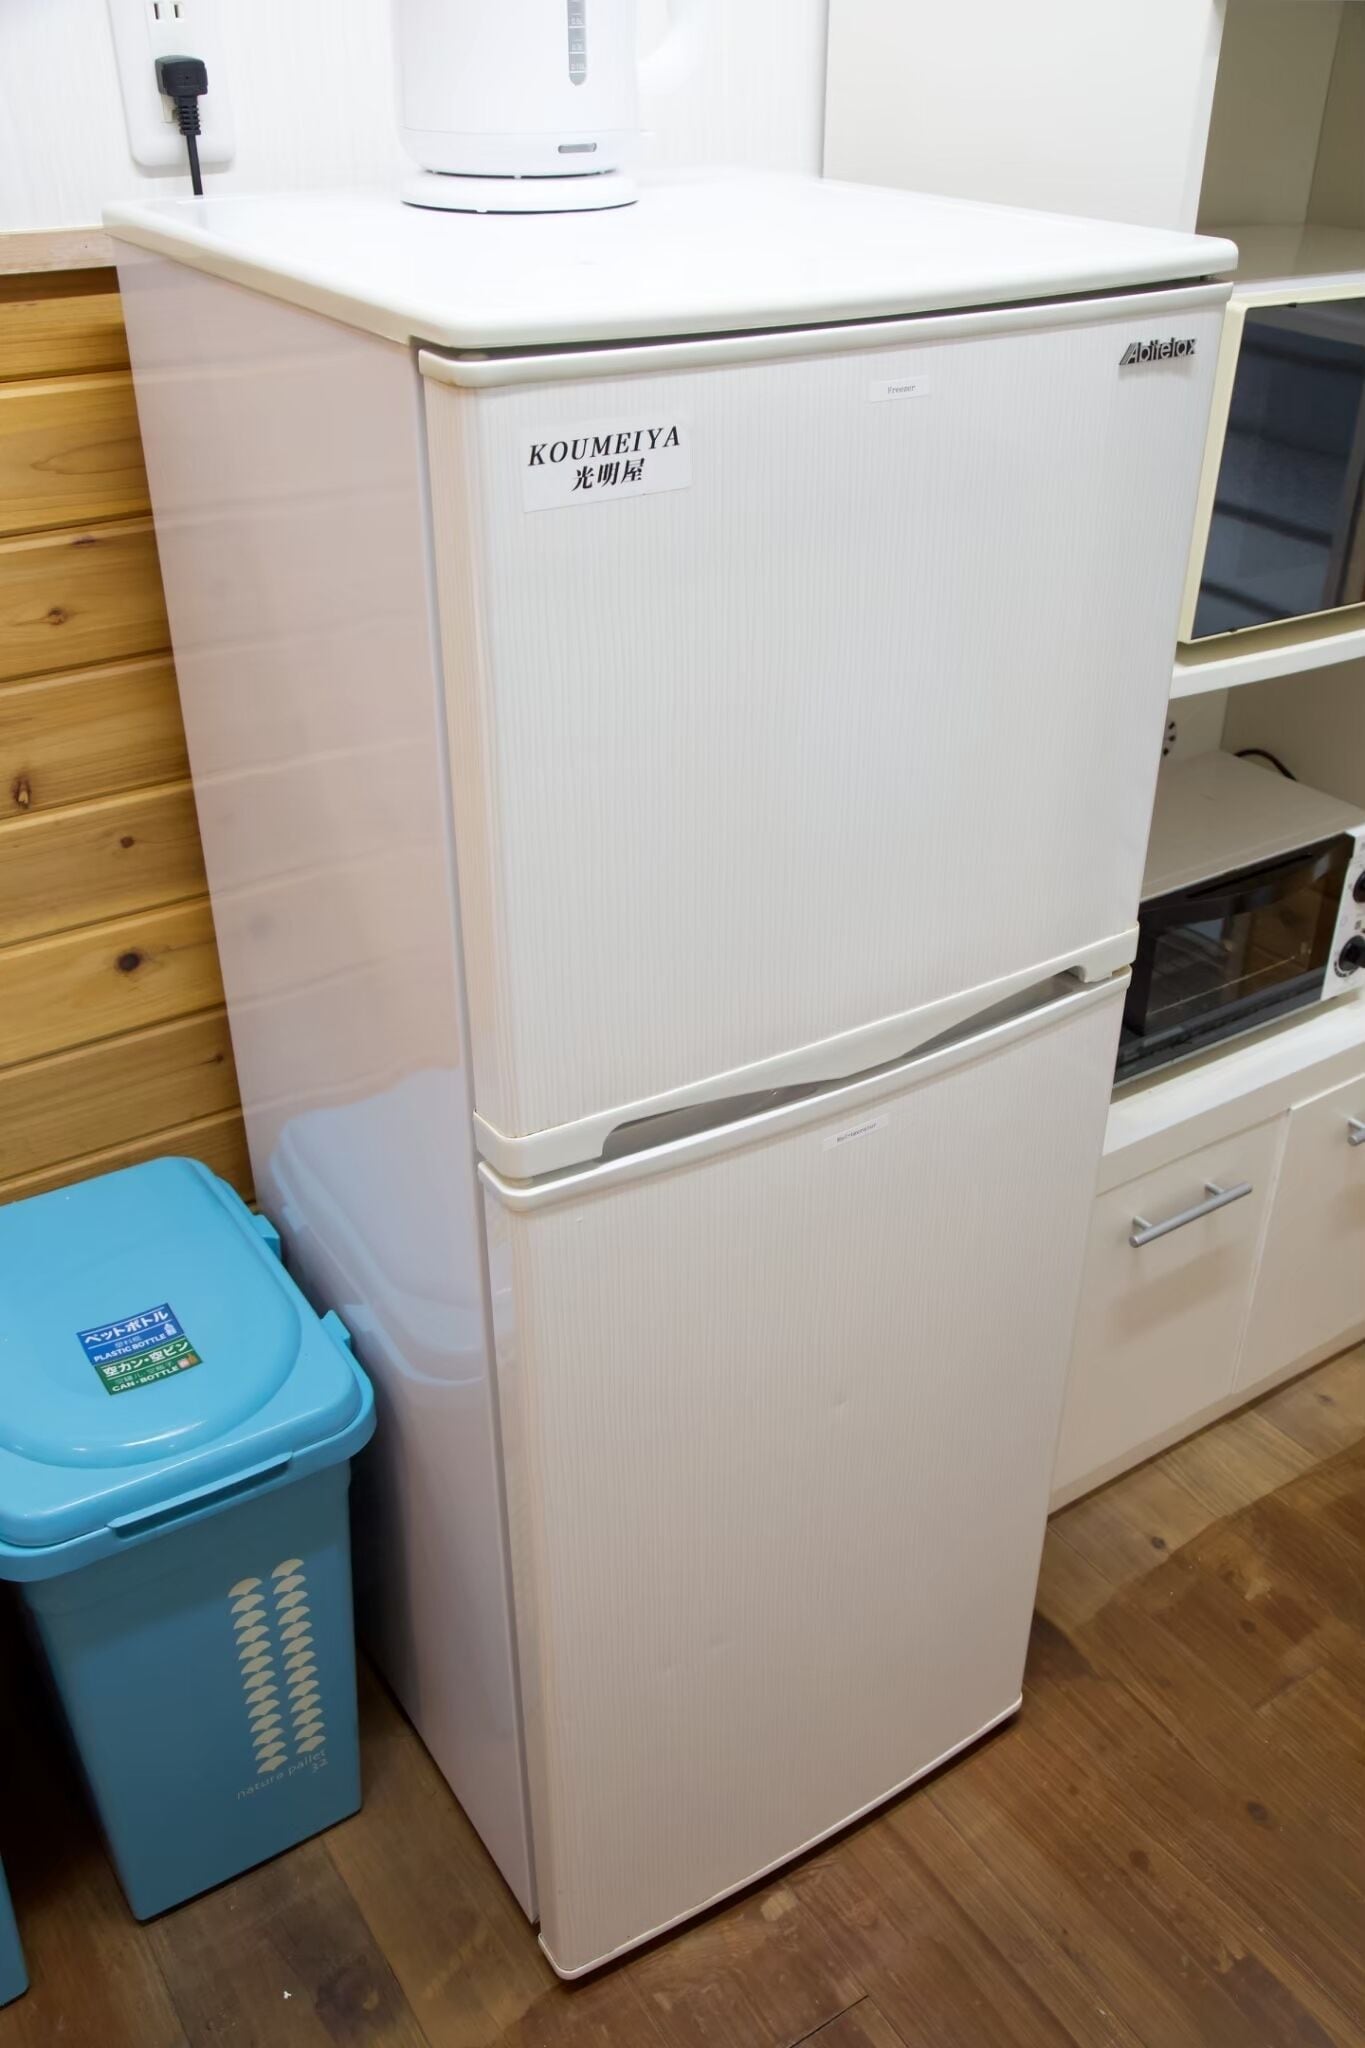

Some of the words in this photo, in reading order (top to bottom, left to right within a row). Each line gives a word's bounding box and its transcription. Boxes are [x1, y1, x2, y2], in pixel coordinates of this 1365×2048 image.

[528, 425, 680, 467] KOUMEIYA
[571, 457, 645, 492] 光明屋
[84, 1311, 168, 1343] ペットボトル
[93, 1346, 132, 1362] PLASTIC
[132, 1333, 167, 1350] BOTTLE
